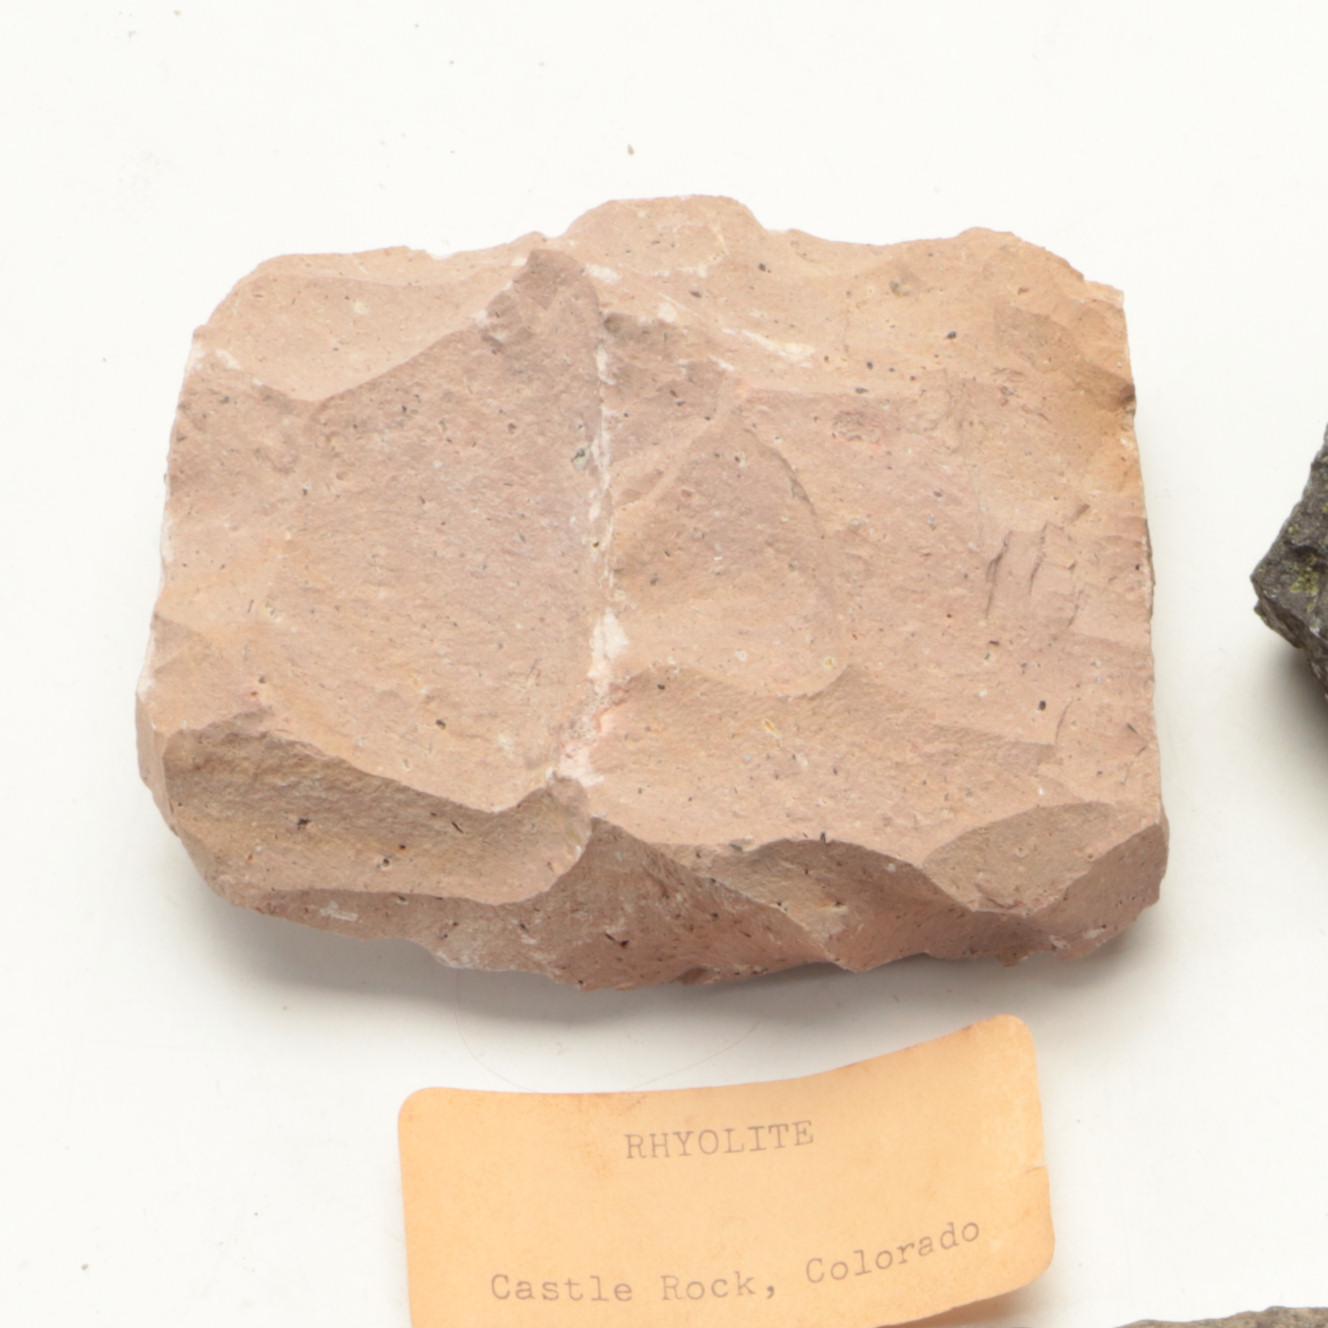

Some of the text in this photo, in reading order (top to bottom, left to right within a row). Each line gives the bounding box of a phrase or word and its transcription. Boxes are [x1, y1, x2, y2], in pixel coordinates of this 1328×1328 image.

[624, 1119, 814, 1160] RHYOLITE
[490, 1221, 980, 1302] Castle Rock, Colorado
